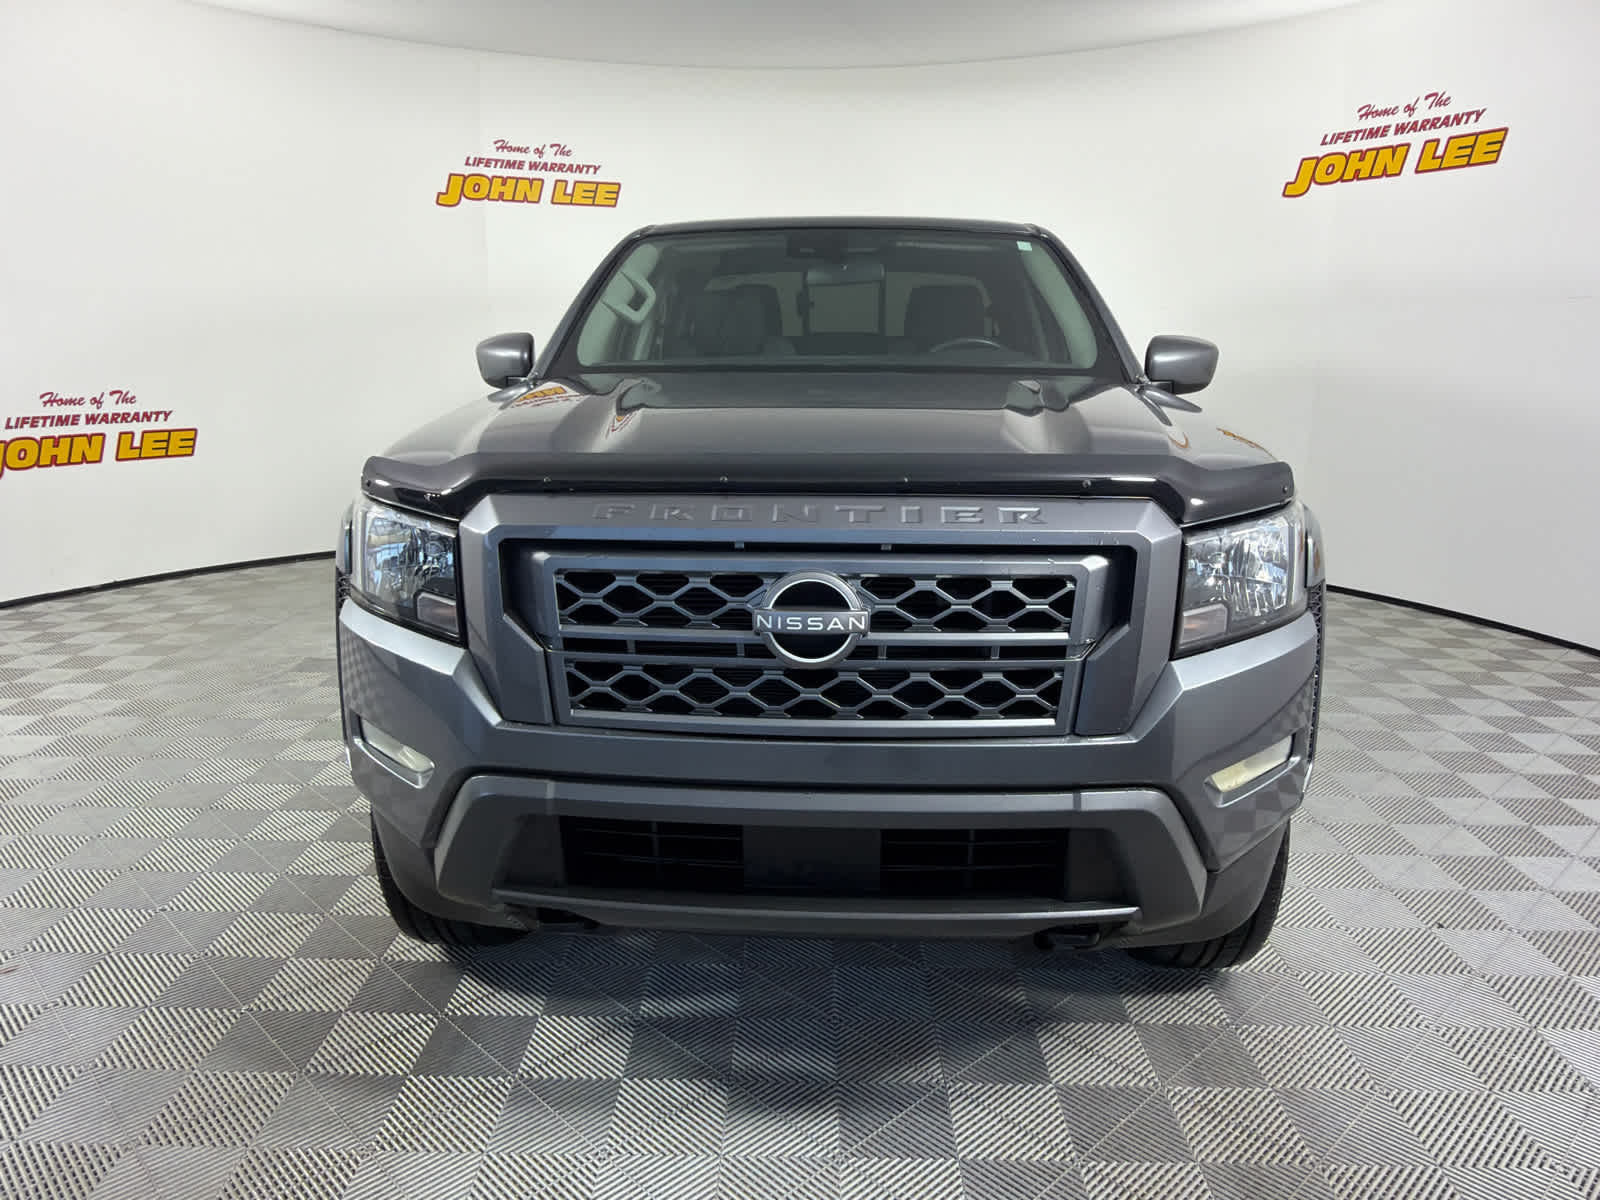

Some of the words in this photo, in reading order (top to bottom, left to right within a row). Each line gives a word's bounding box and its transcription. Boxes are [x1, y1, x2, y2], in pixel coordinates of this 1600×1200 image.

[1357, 104, 1399, 121] Home
[1403, 97, 1420, 118] of
[1424, 90, 1452, 110] The
[1320, 125, 1392, 146] LIFETIME
[1393, 108, 1487, 136] WARRANTY
[493, 139, 530, 154] Home
[533, 144, 547, 158] of
[550, 143, 573, 157] The
[464, 156, 526, 170] LIFETIME
[528, 161, 602, 175] WARRANTY
[1282, 143, 1411, 198] JOHN
[1414, 127, 1509, 174] LEE
[436, 173, 544, 207] JOHN
[551, 179, 621, 208] LEE
[40, 391, 86, 407] Home
[89, 392, 104, 409] of
[109, 390, 136, 405] The
[5, 414, 81, 430] LIFETIME
[85, 410, 173, 426] WARRANTY
[0, 433, 106, 480] OHN
[115, 428, 197, 462] LEE
[592, 503, 1049, 525] FRONTIER
[756, 614, 866, 631] NISSAN
